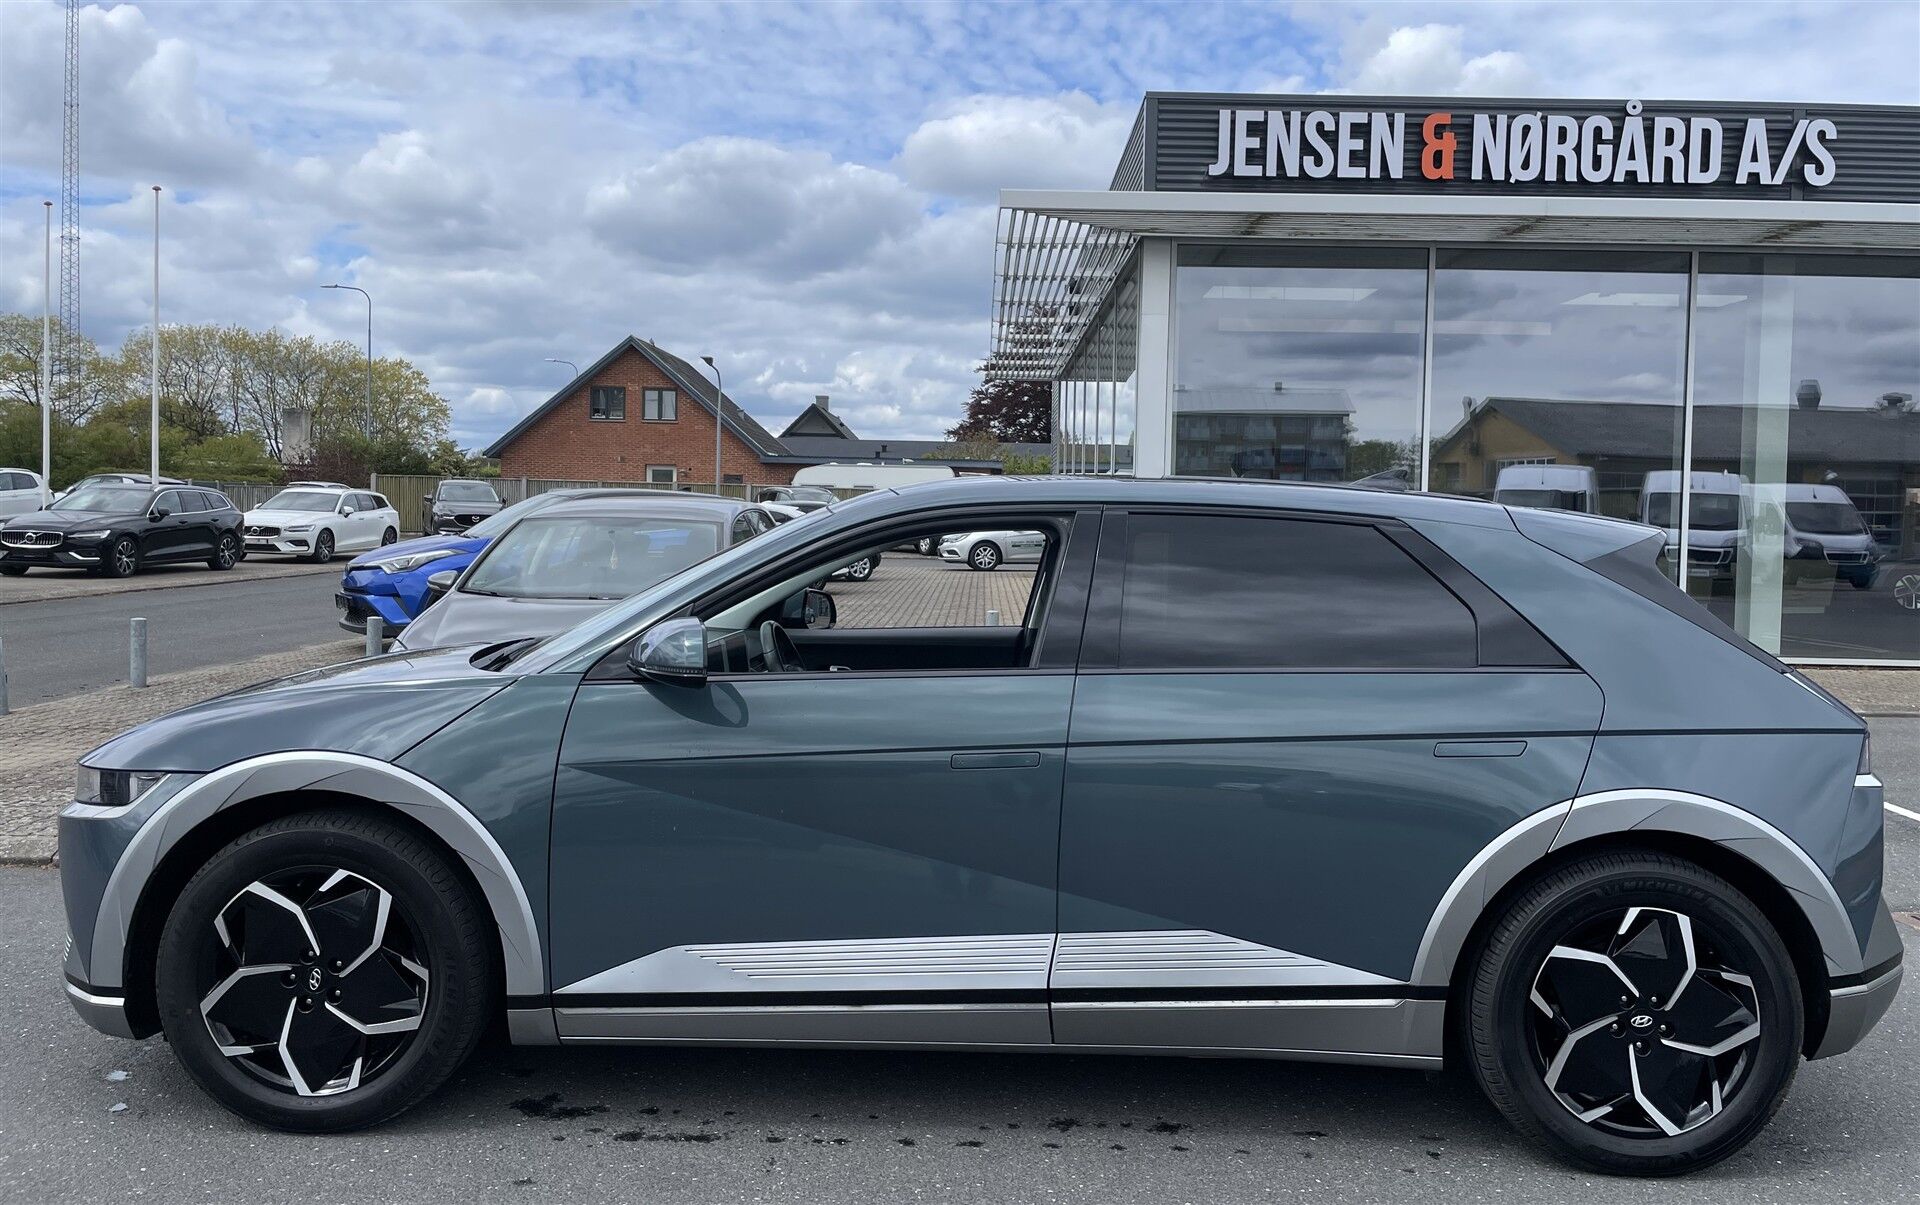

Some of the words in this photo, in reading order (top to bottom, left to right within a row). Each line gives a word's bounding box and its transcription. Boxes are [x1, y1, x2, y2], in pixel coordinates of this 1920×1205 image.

[1208, 109, 1406, 179] JENSEN
[1421, 112, 1457, 180] &
[1471, 99, 1723, 185] NØRGÅRD
[1735, 117, 1838, 188] A/S
